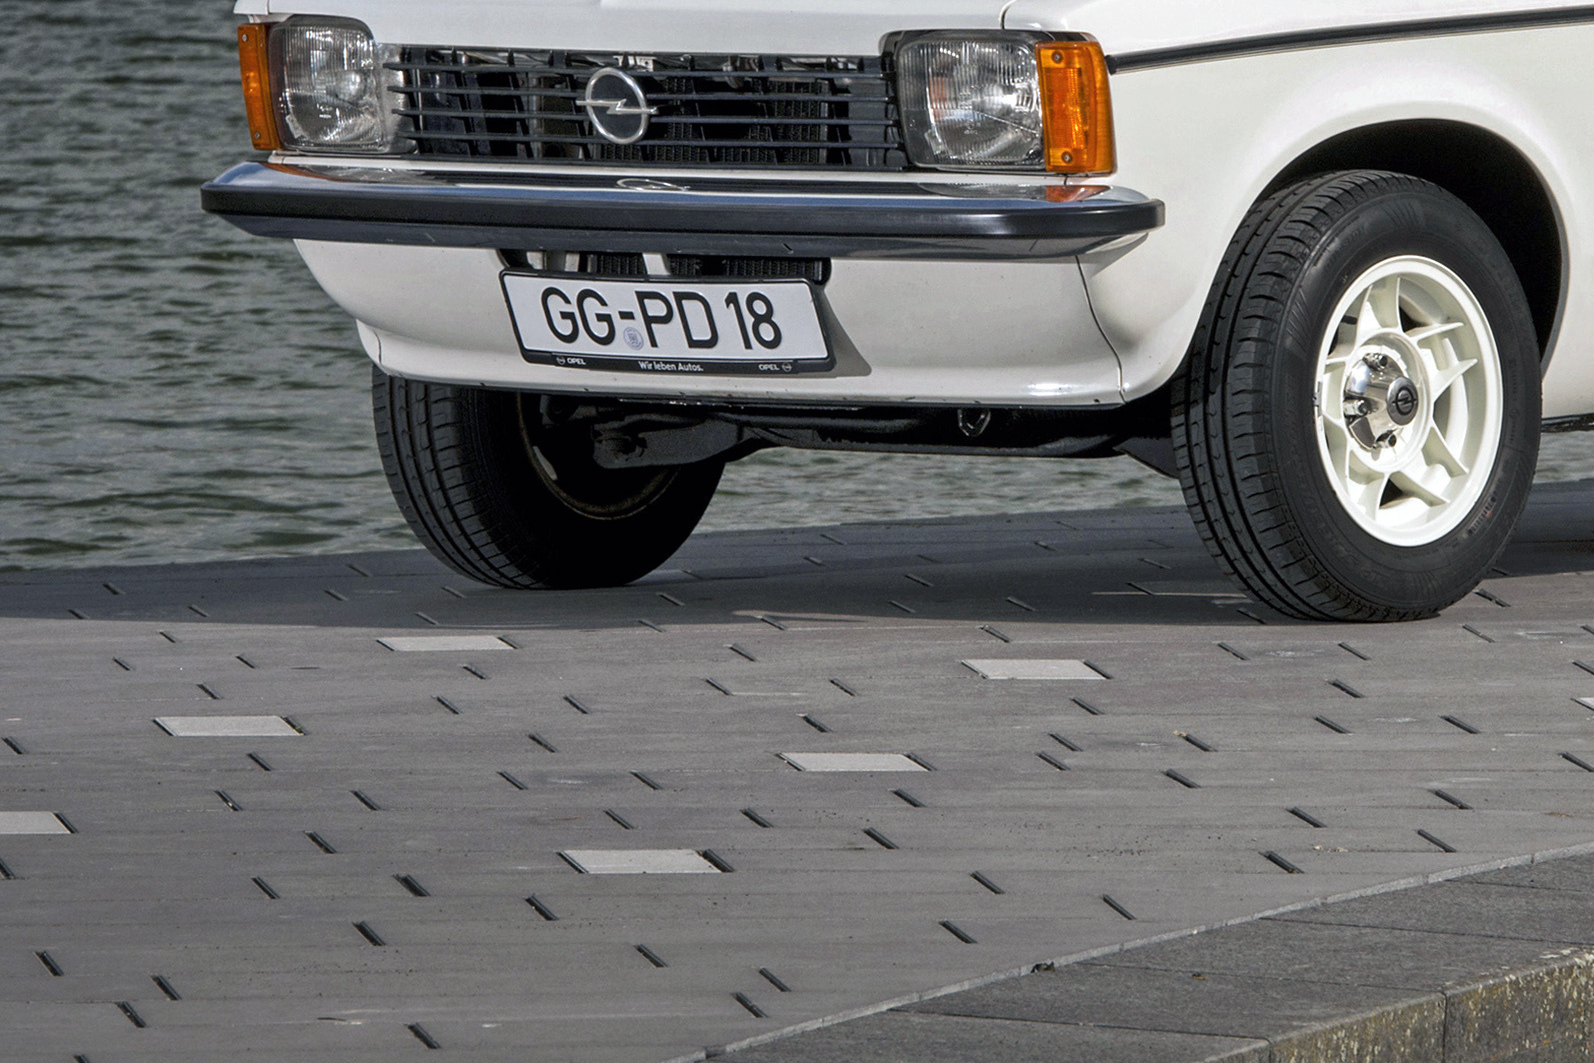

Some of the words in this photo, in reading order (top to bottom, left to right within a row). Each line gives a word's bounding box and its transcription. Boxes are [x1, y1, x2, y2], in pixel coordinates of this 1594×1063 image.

[724, 291, 783, 350] 18
[567, 357, 586, 366] OPEL
[638, 360, 652, 370] Wir
[654, 361, 676, 371] leben
[678, 362, 704, 372] Autos.
[758, 363, 780, 371] OPEL
